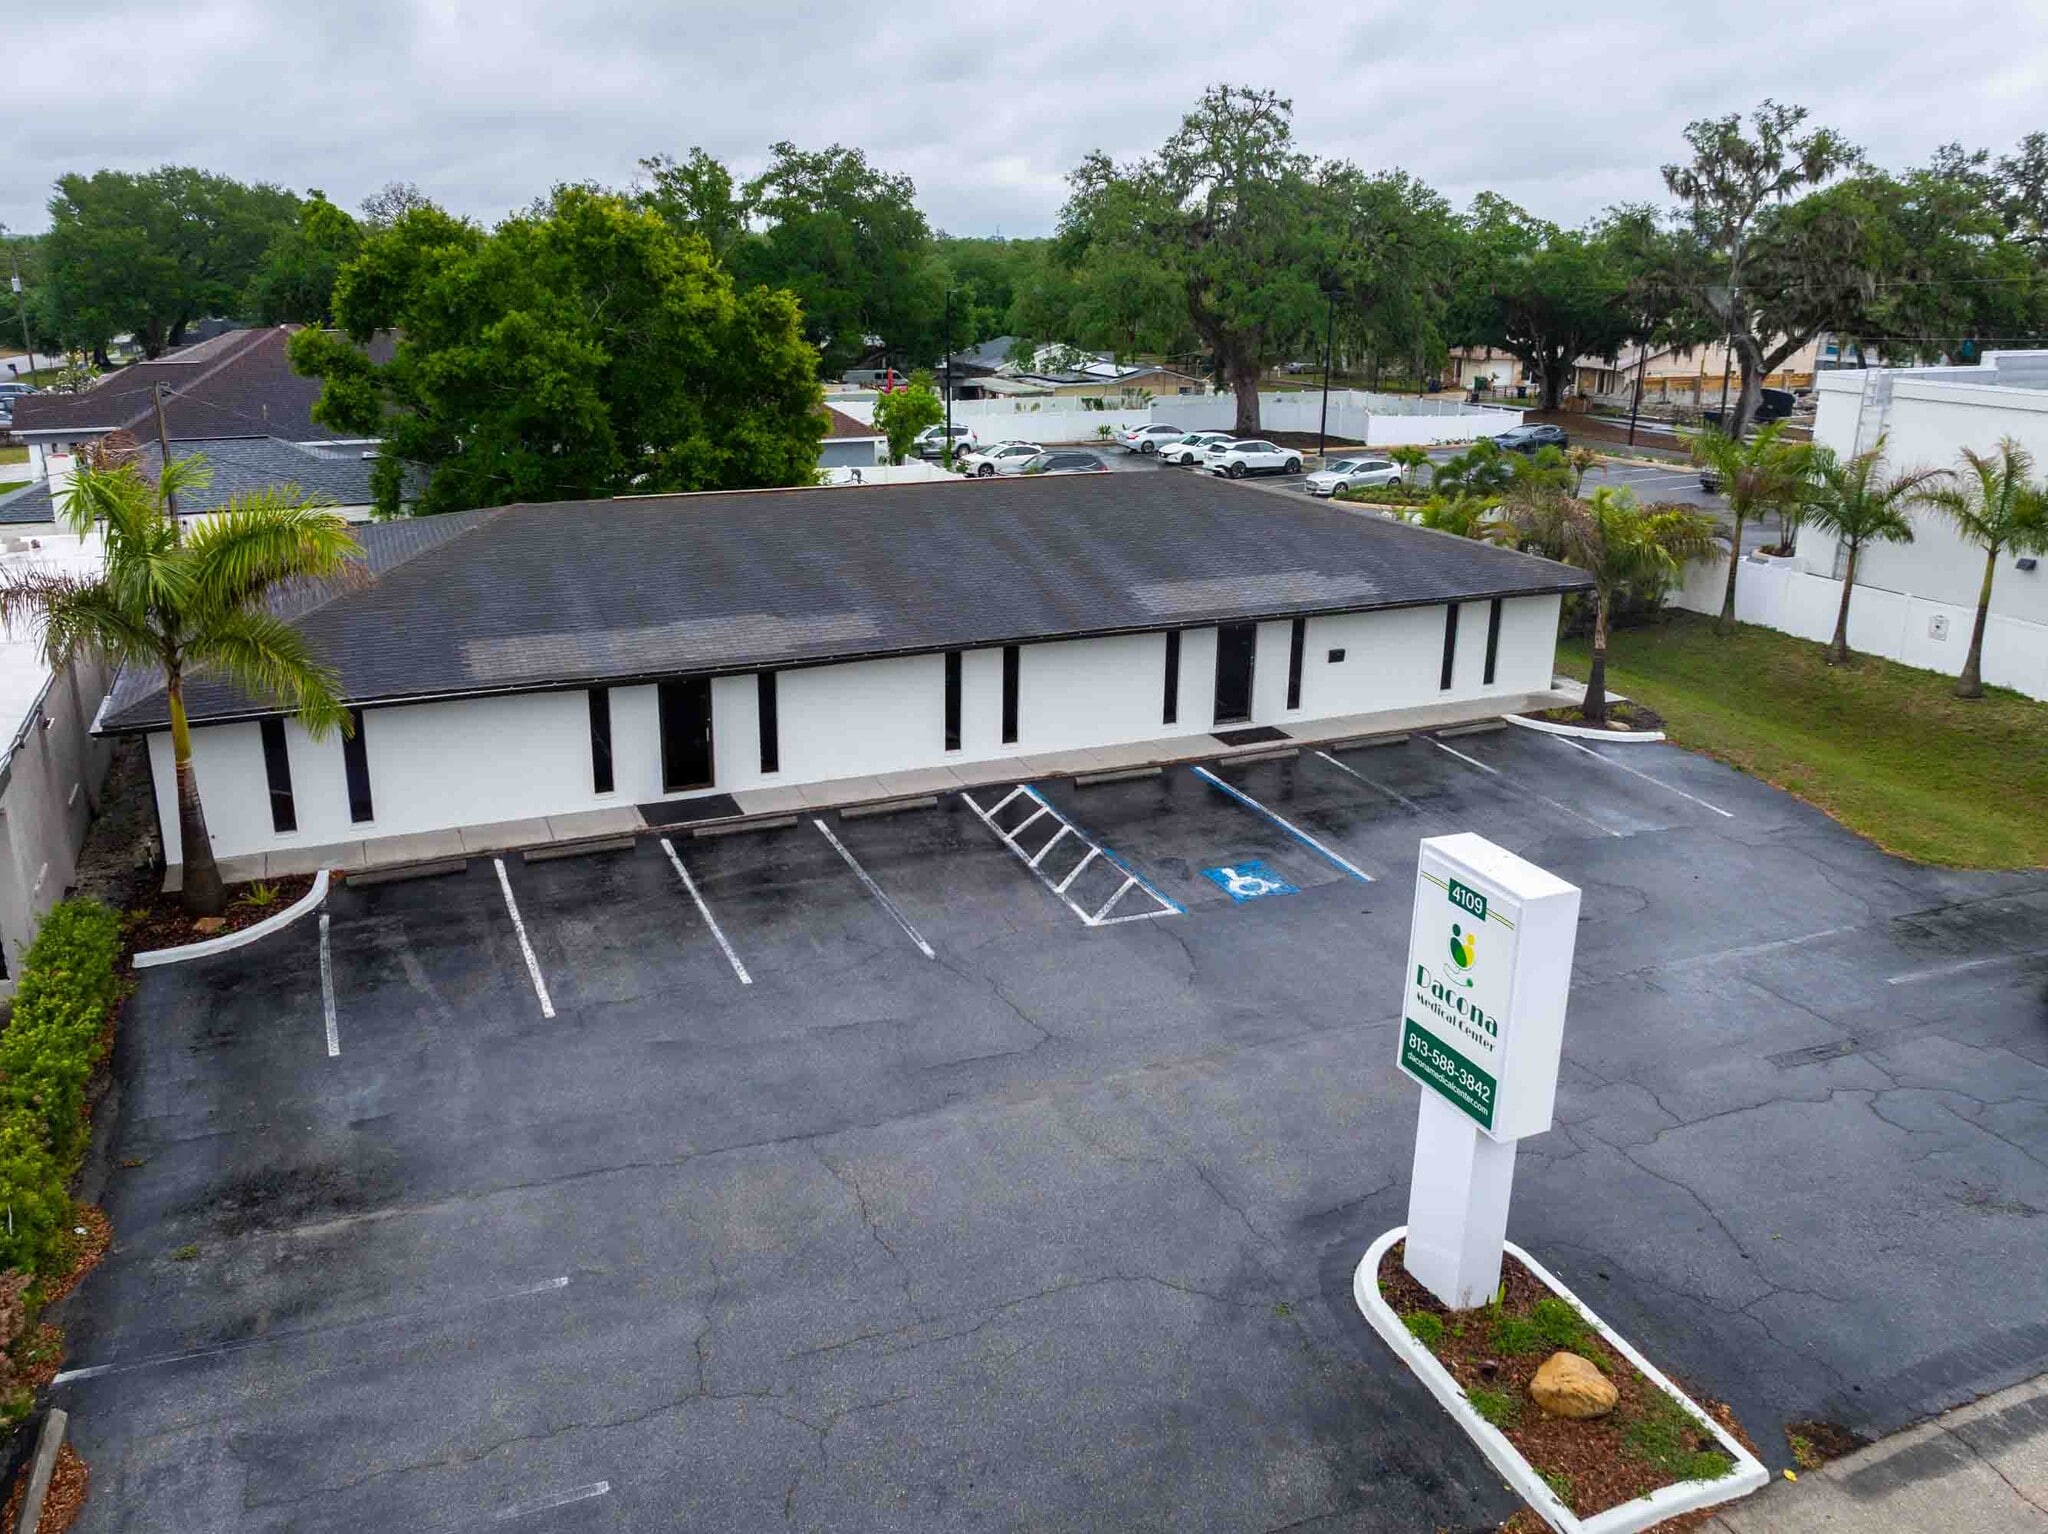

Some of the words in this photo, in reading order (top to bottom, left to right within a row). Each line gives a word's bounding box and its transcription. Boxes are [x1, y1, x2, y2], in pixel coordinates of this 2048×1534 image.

[1452, 886, 1483, 914] 4109
[1417, 964, 1498, 1038] Dacona
[1417, 992, 1456, 1027] Medical
[1459, 1020, 1496, 1053] Center
[1408, 1052, 1488, 1116] daconamedicalcenter.com
[1409, 1033, 1491, 1103] 813-588-3842
